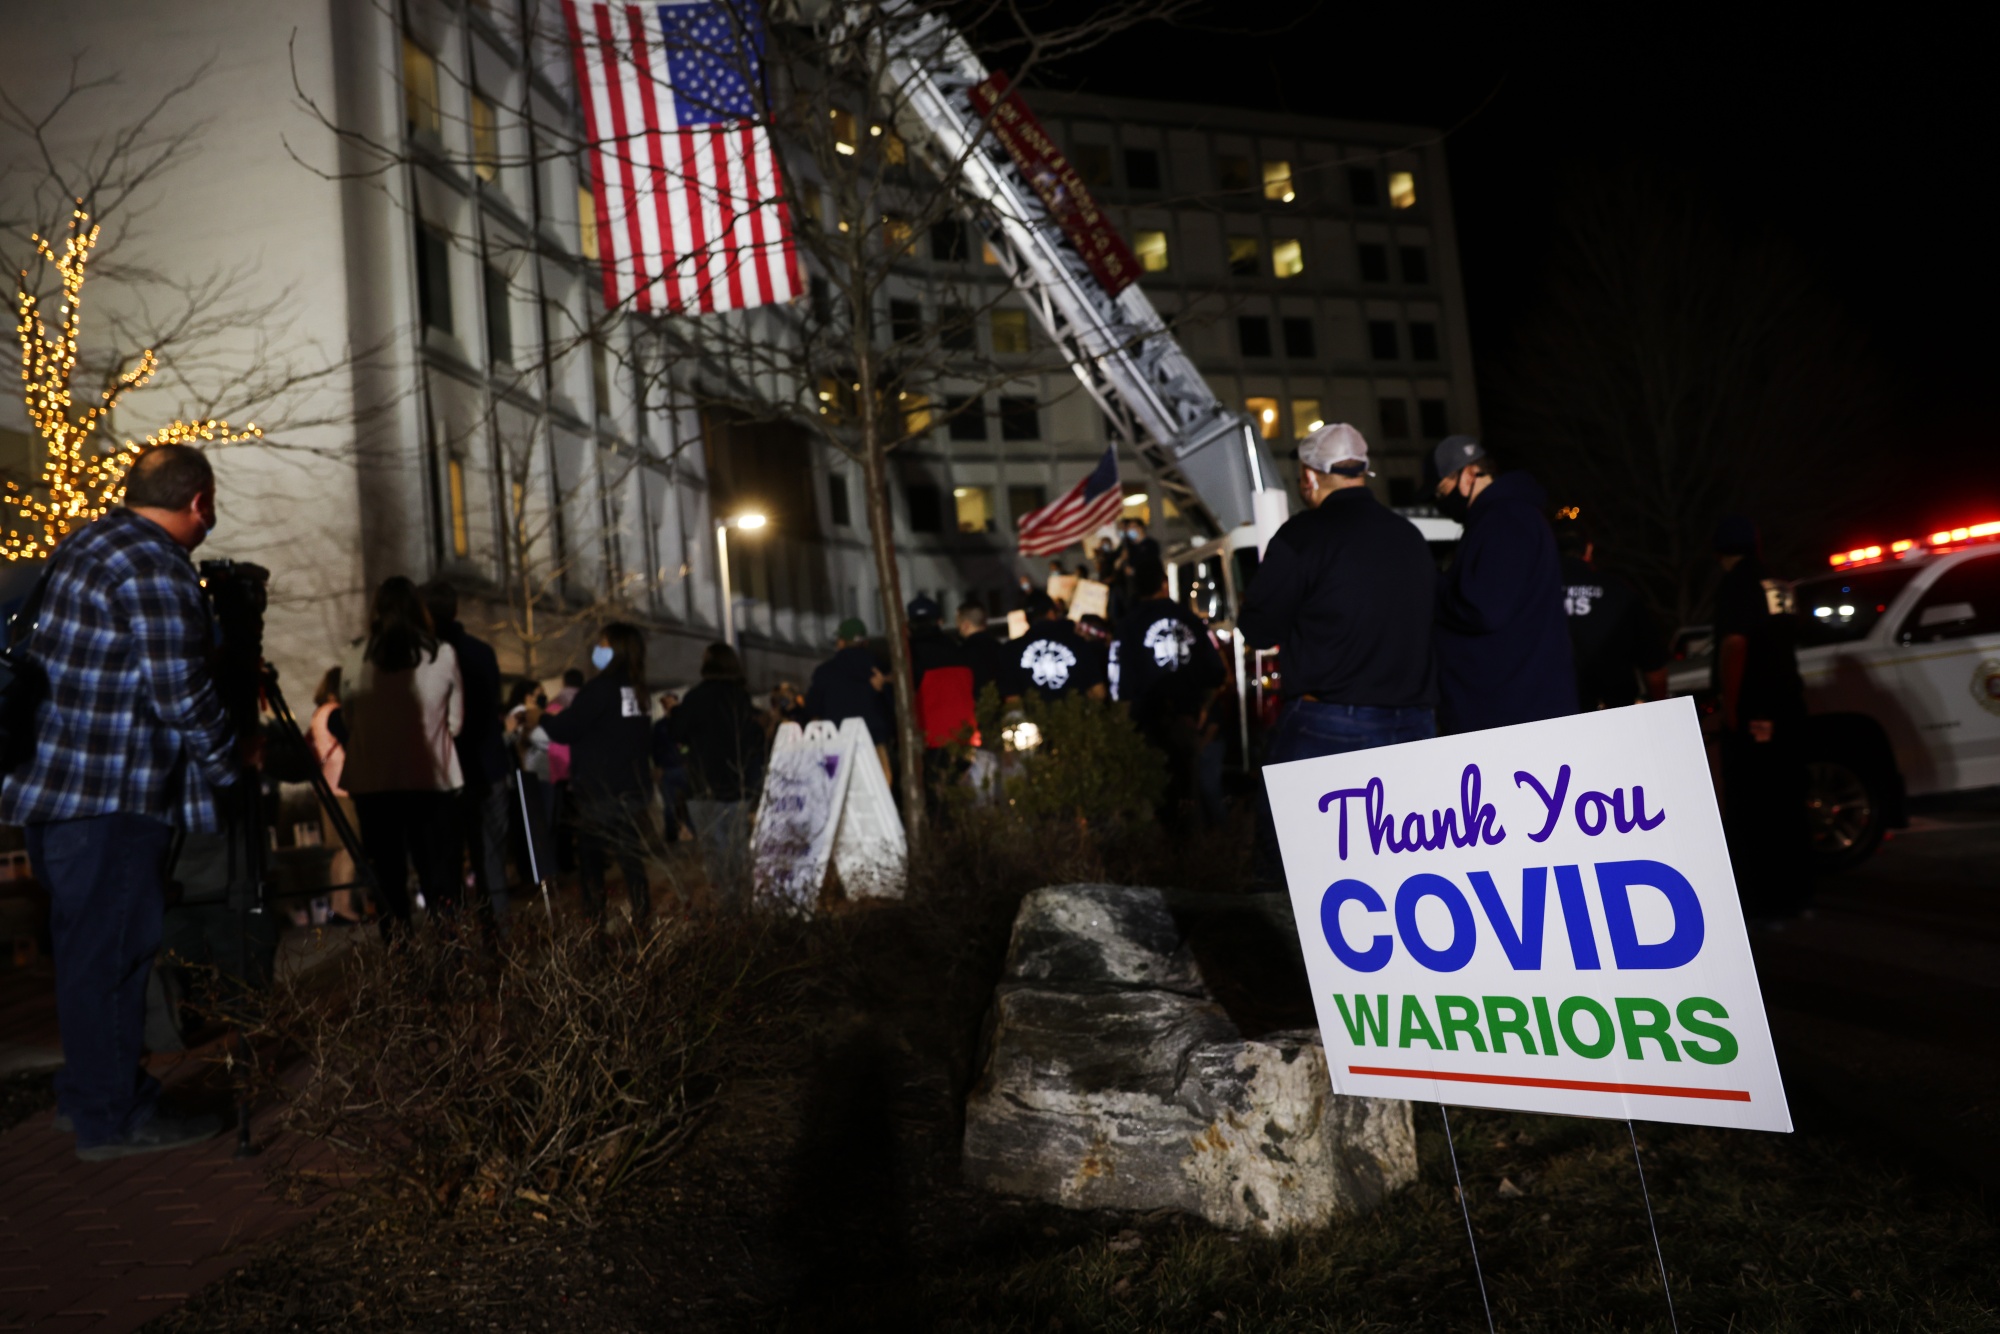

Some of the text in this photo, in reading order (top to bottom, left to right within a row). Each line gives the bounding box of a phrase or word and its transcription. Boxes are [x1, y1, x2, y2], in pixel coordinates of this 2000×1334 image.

[1319, 764, 1665, 860] Thank You
[1320, 859, 1705, 972] COVID
[1333, 994, 1739, 1065] WARRIORS
